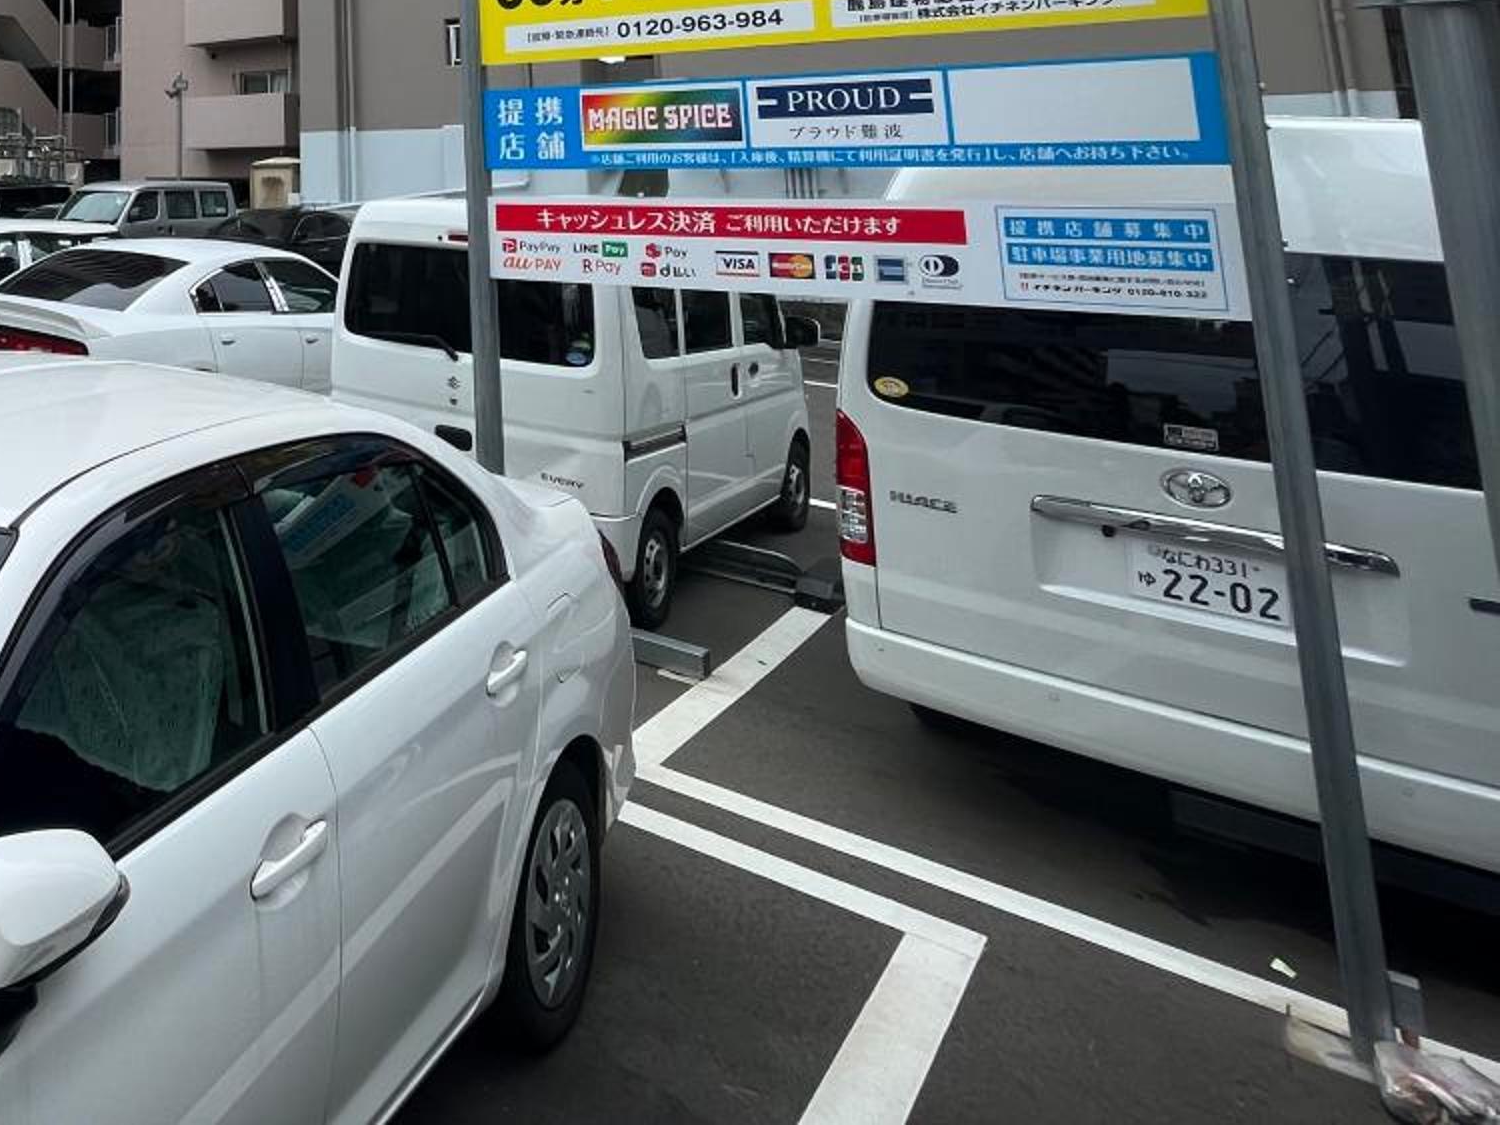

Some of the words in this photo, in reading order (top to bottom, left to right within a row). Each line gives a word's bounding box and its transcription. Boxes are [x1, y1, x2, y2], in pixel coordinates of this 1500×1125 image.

[617, 9, 783, 38] 0120-963-984
[496, 97, 563, 126] 提携
[787, 86, 901, 112] PROUD
[587, 106, 658, 132] MAGIC
[499, 133, 565, 160] 店舗
[537, 209, 716, 234] キャッシュレス決済
[727, 213, 902, 235] ご利用いただけます
[519, 240, 561, 254] PayPay
[573, 243, 599, 254] LINE
[605, 243, 625, 255] Pay
[535, 258, 561, 271] PAY
[596, 260, 621, 275] Pay
[723, 258, 755, 270] VISA
[1163, 569, 1281, 621] 22-02
